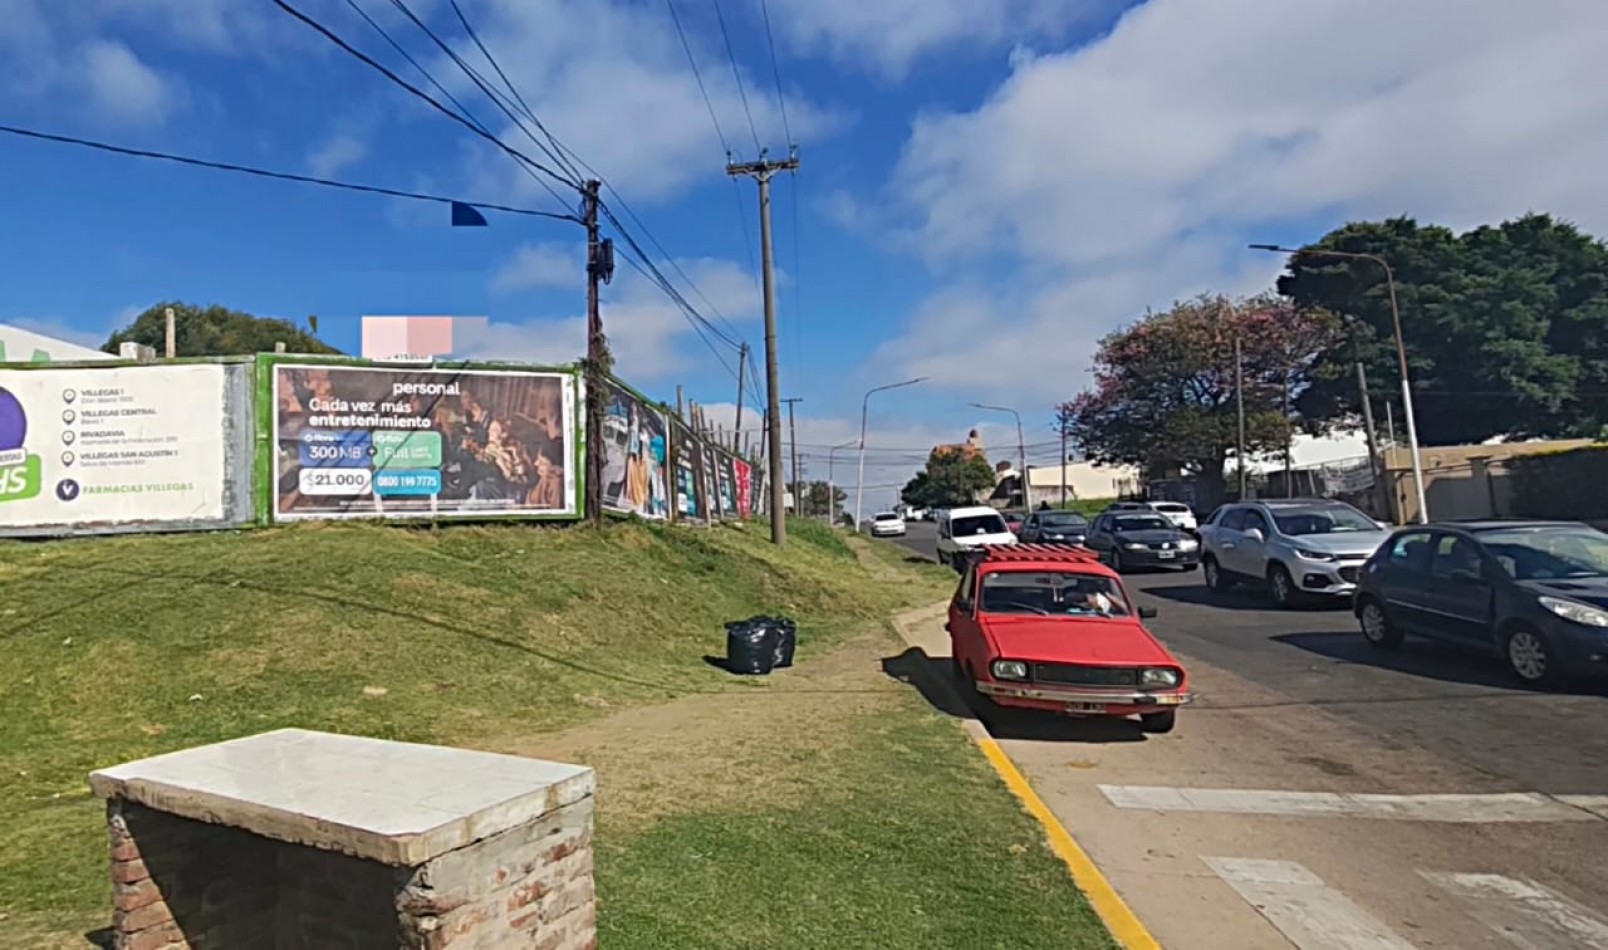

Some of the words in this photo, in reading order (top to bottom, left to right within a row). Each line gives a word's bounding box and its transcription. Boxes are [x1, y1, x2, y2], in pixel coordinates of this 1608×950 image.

[80, 388, 119, 397] VILLEGAS
[392, 382, 461, 397] personal
[309, 398, 348, 412] Cada
[351, 401, 376, 412] vez
[381, 400, 412, 414] más
[80, 409, 119, 418] VILLEGAS
[120, 408, 156, 416] CENTRAL
[309, 414, 431, 429] entretenimiento
[80, 430, 125, 438] RIVADAVIA
[79, 451, 119, 460] VILLEGAS
[120, 450, 137, 458] SAN
[308, 445, 338, 459] 300
[339, 445, 361, 459] MB
[377, 475, 399, 487] 0800
[82, 483, 143, 495] FARMACIAS
[146, 482, 194, 492] VILLEGAS
